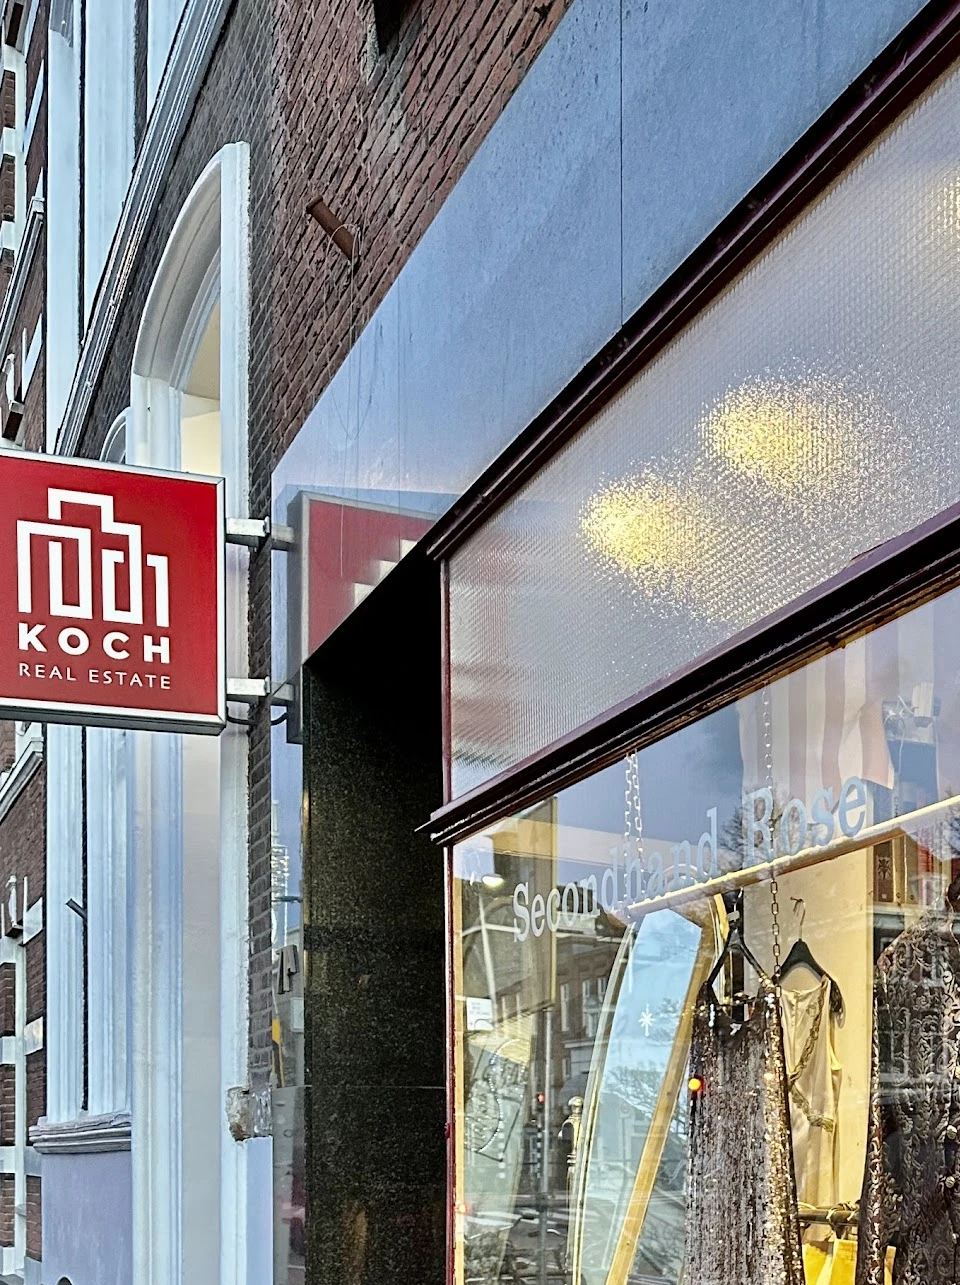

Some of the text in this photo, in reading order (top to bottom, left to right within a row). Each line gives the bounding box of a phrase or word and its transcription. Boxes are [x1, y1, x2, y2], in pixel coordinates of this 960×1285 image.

[18, 622, 171, 664] KOCH
[18, 662, 172, 690] REAL ESTATE
[512, 775, 868, 942] Secondhand Rose
